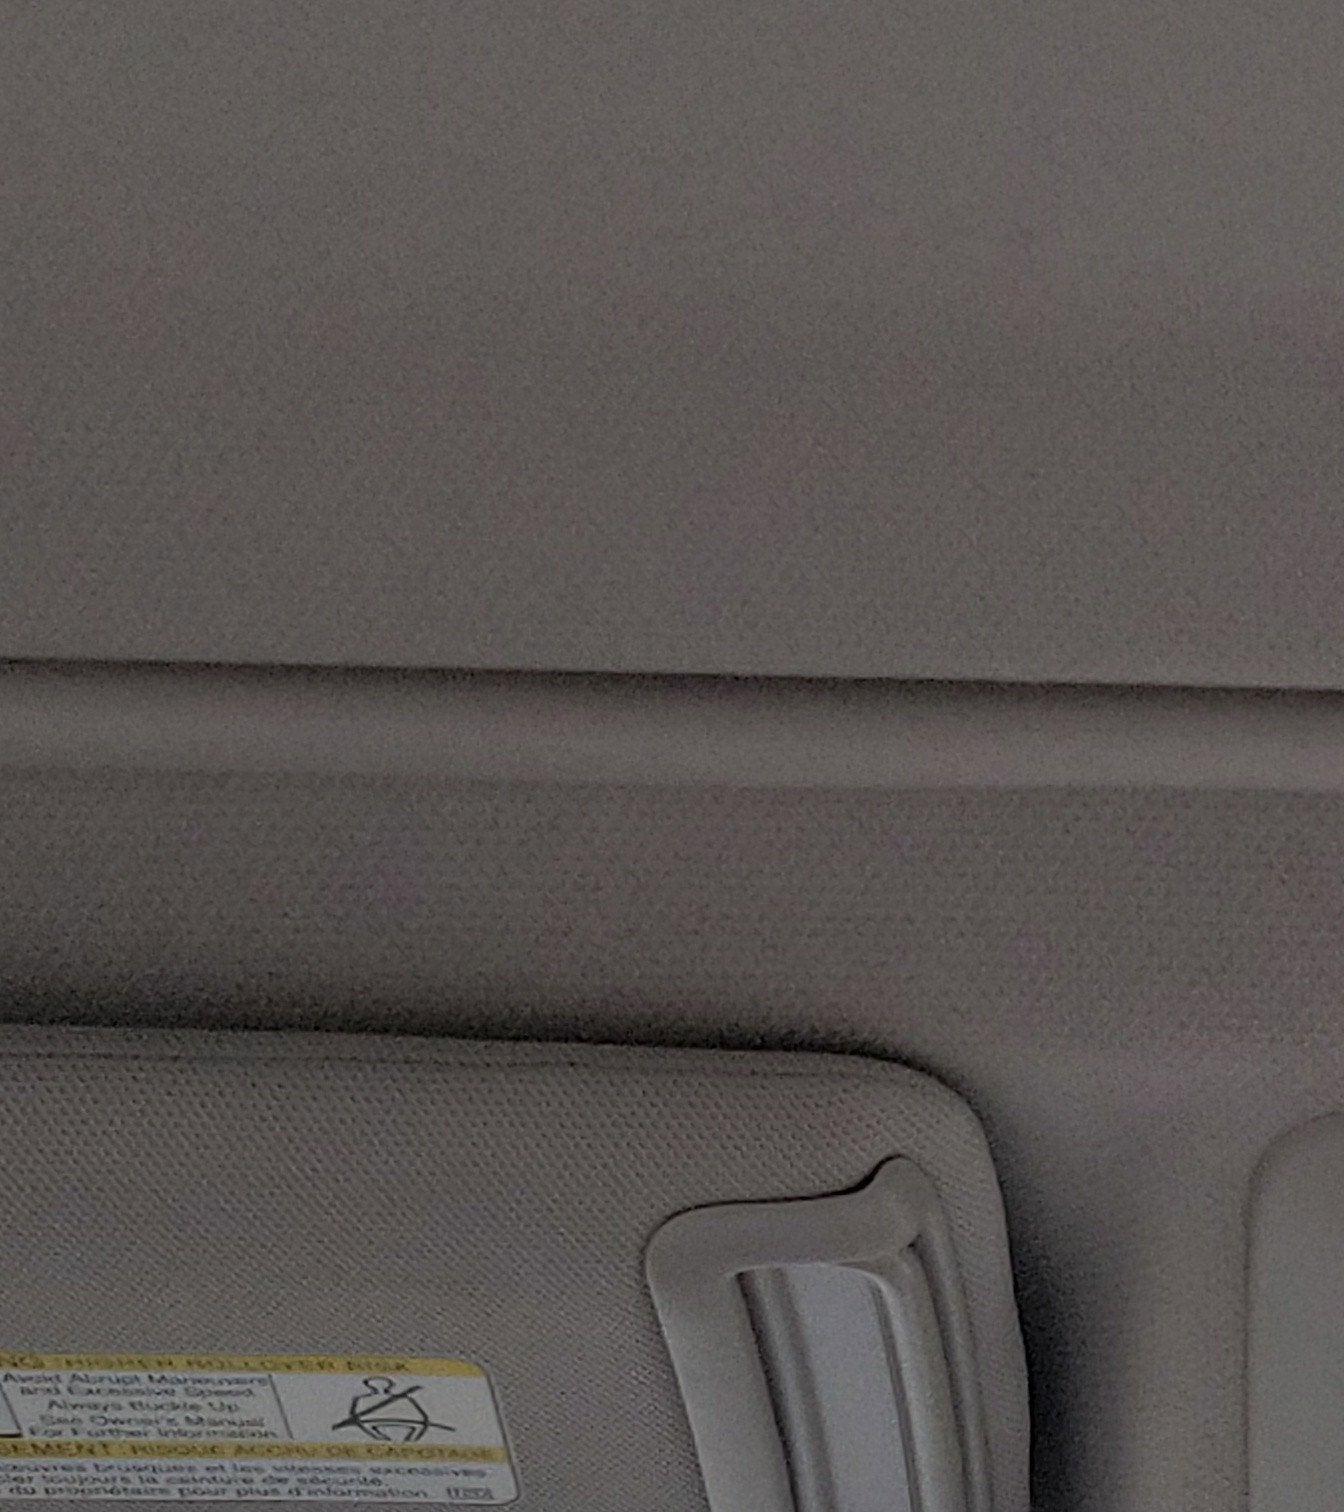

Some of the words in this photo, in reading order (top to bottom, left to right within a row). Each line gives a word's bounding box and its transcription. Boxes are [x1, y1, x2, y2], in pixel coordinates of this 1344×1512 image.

[70, 1373, 141, 1387] Abrupt
[48, 1400, 124, 1412] Always
[128, 1400, 203, 1412] Buckle
[39, 1414, 84, 1427] See
[184, 1416, 265, 1428] Manual
[29, 1426, 63, 1438] For
[71, 1427, 149, 1438] Further
[204, 1464, 225, 1474] et
[138, 1474, 160, 1485] la
[261, 1475, 290, 1486] de
[9, 1485, 37, 1496] du
[178, 1487, 227, 1499] pour
